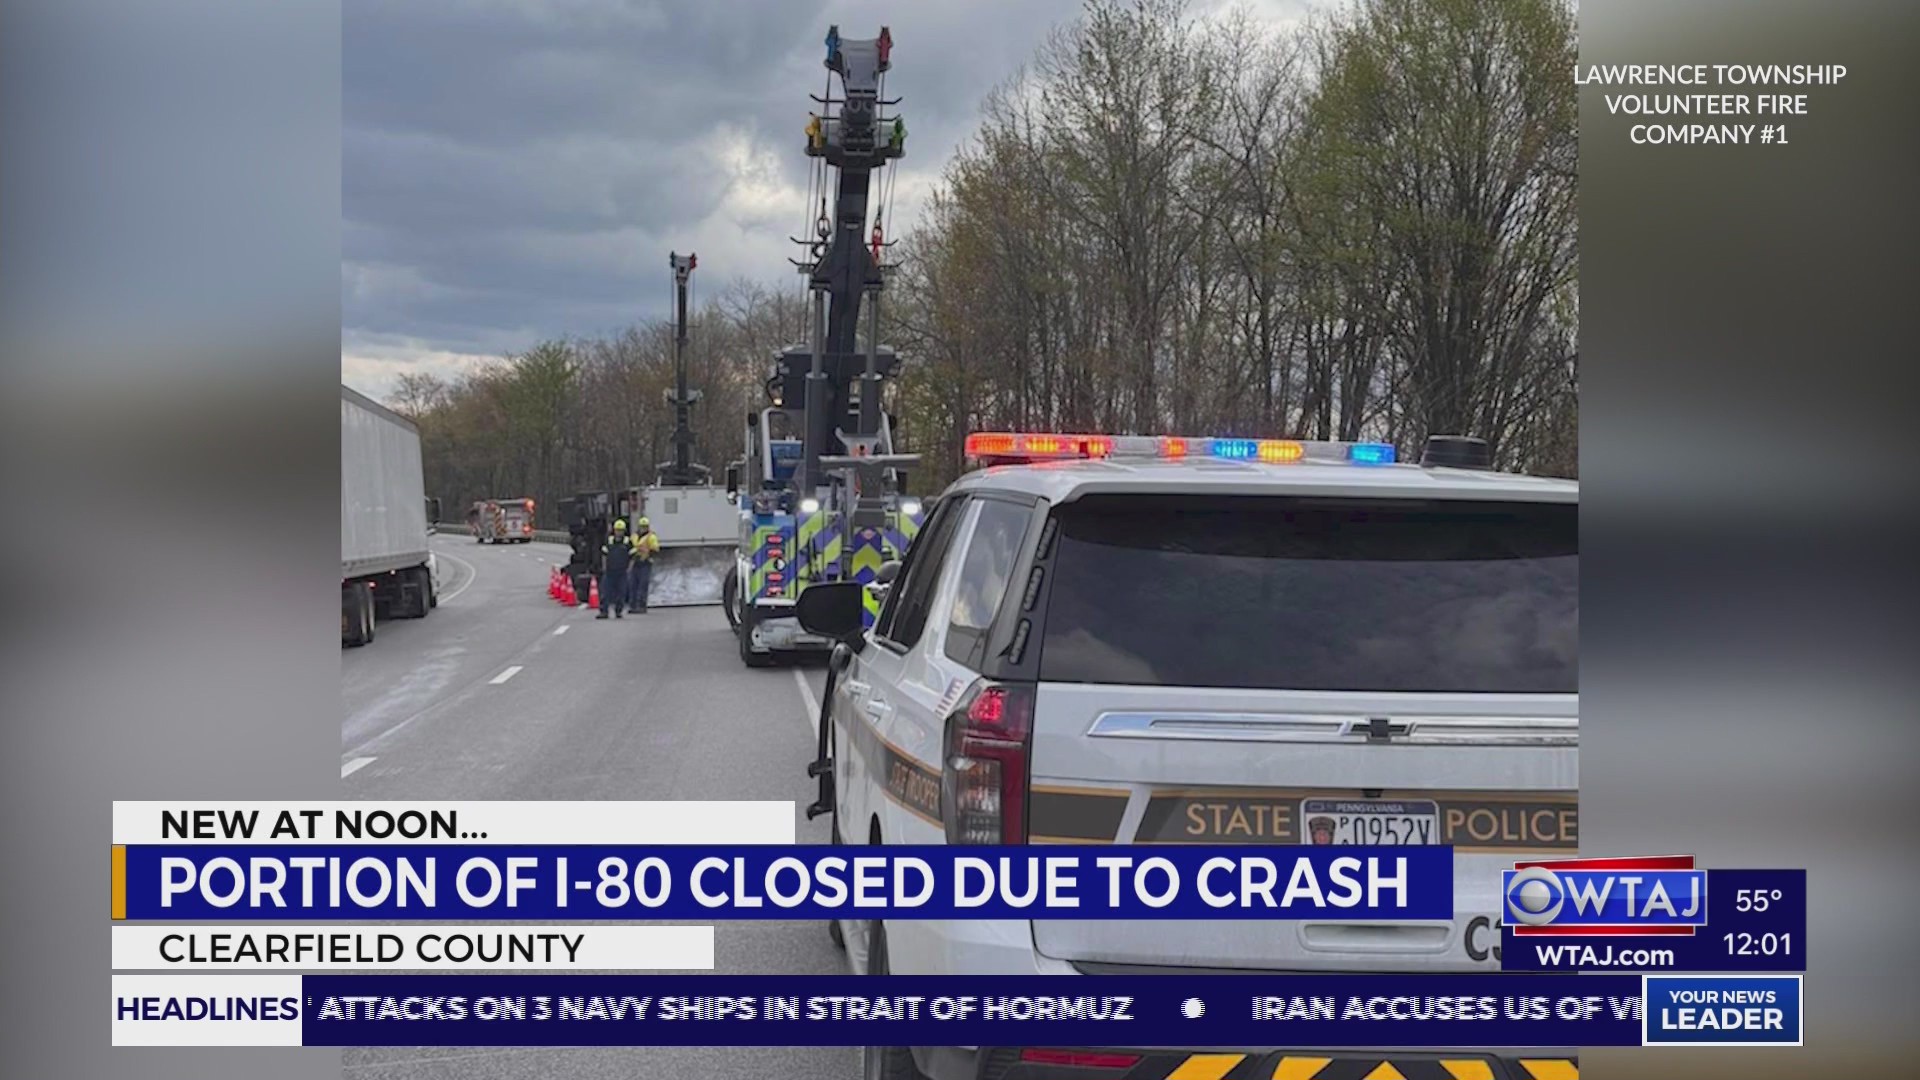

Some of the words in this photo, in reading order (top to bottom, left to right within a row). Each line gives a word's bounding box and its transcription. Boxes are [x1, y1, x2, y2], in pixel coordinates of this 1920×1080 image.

[1336, 803, 1404, 813] PENNSYLVANIA
[1186, 803, 1291, 837] STATE
[1446, 808, 1577, 843] POLICE
